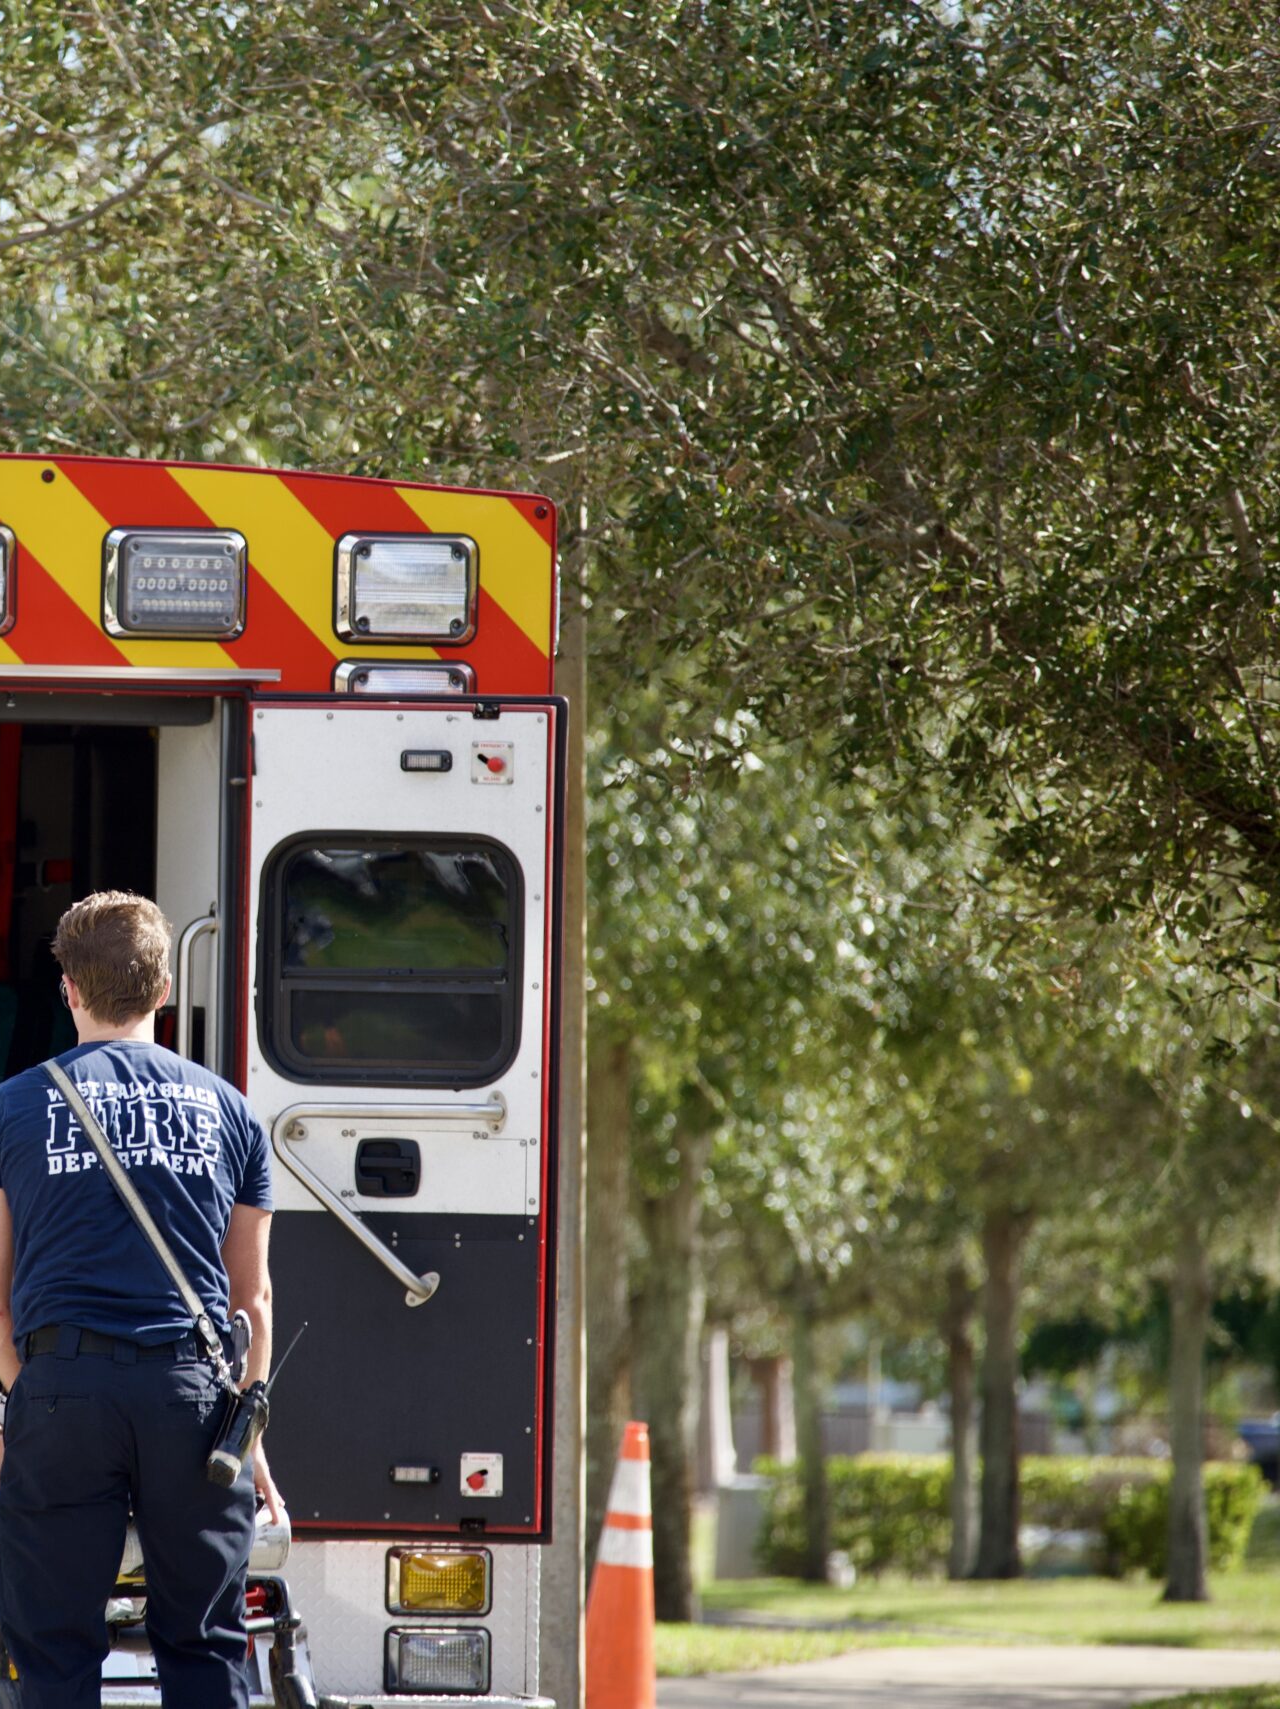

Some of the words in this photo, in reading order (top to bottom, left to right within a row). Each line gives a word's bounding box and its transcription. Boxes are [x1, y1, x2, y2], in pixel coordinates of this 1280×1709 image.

[46, 1080, 100, 1102] WST
[105, 1081, 156, 1101] PALM
[160, 1082, 218, 1107] BEACH
[46, 1096, 221, 1162] FIRE
[47, 1148, 216, 1179] DEPRTMENT
